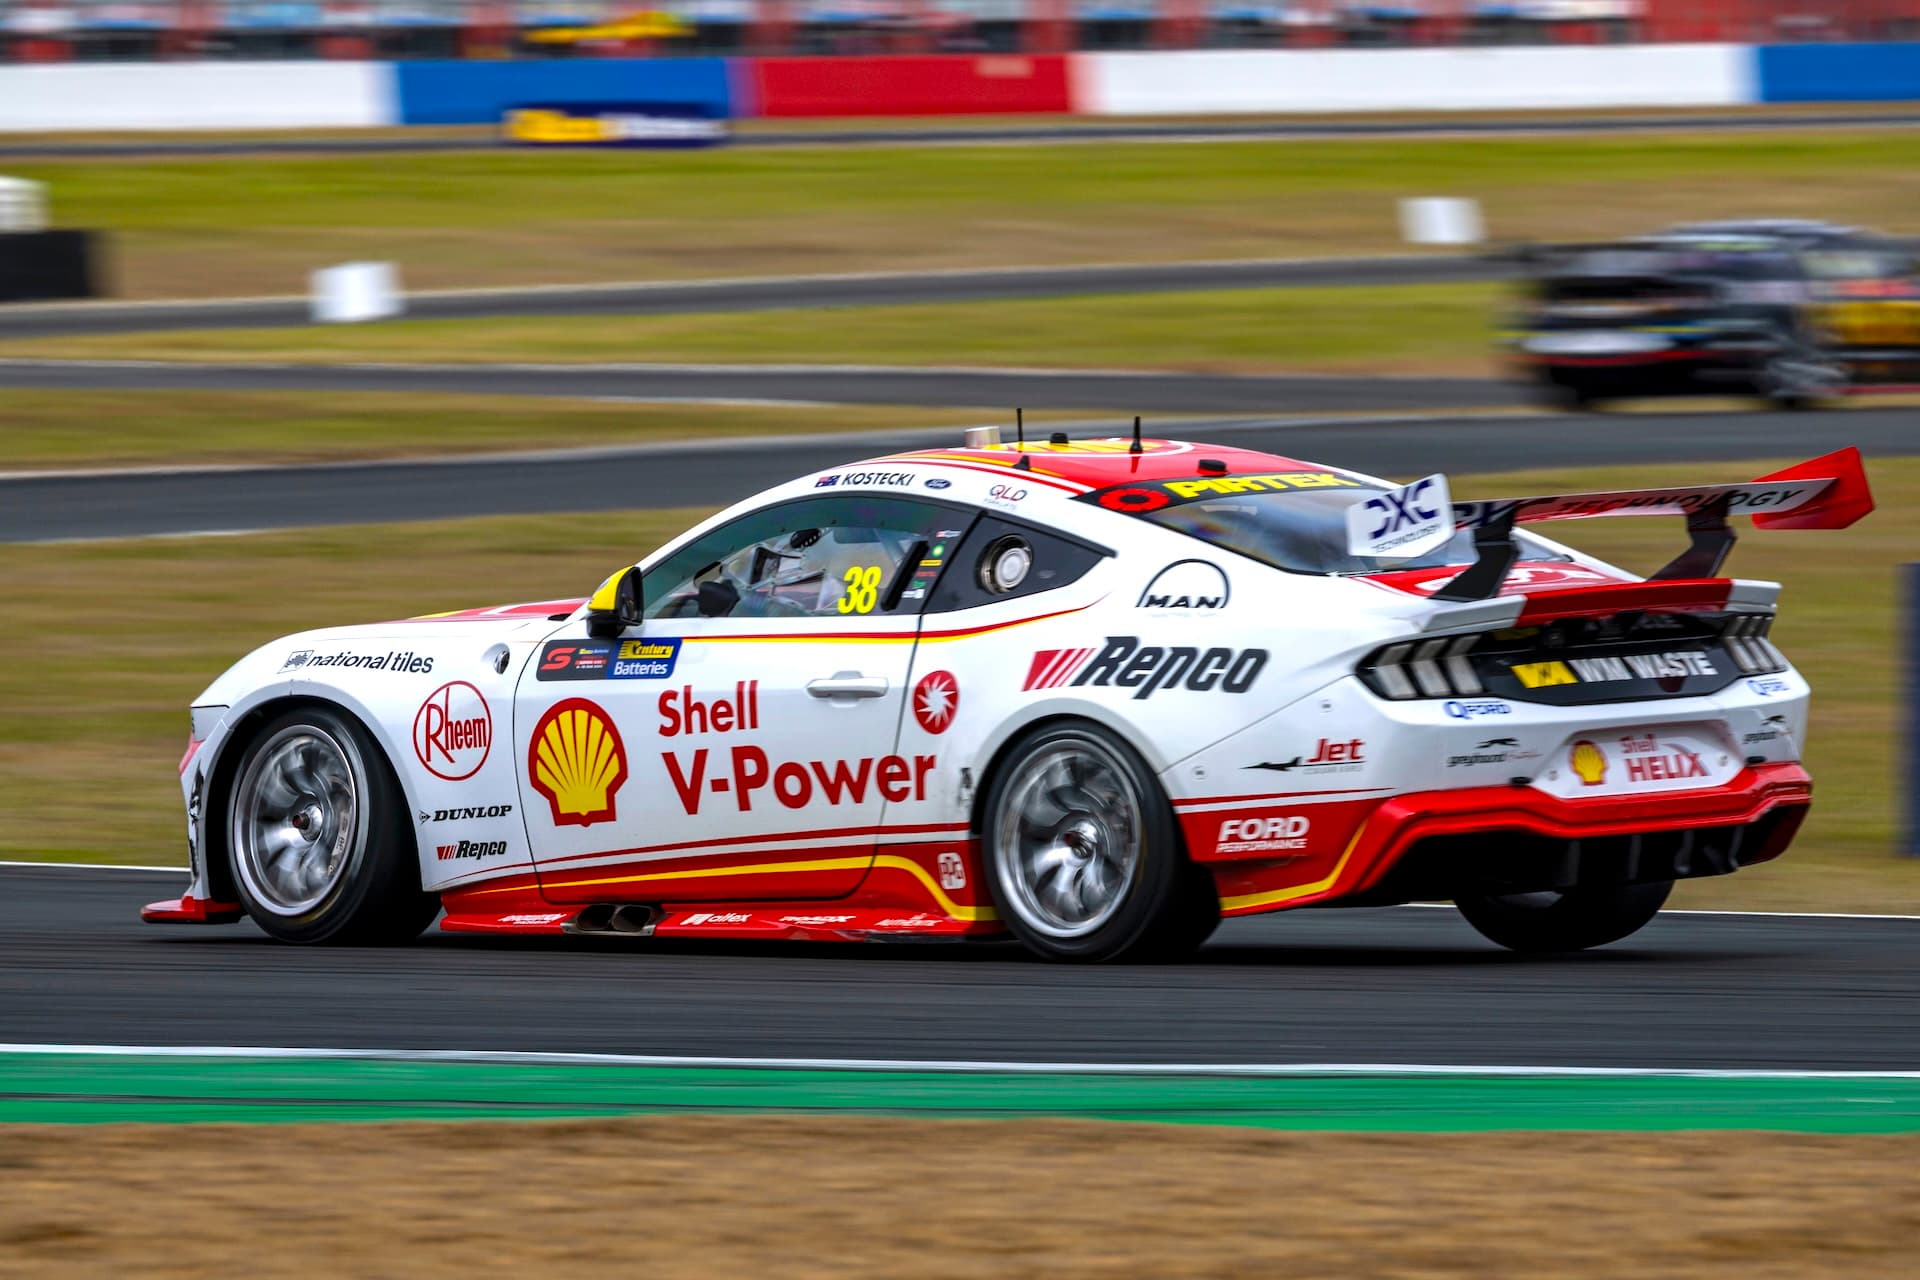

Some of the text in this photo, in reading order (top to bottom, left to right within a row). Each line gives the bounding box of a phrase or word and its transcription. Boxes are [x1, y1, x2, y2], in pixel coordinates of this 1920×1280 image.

[842, 472, 915, 486] KOSTECKI
[1163, 473, 1360, 498] PIRTEK
[990, 484, 1028, 501] QLD
[837, 566, 882, 614] 38
[1143, 594, 1223, 608] MAN
[630, 640, 674, 656] Century
[306, 651, 434, 673] national tiles
[613, 660, 669, 676] Batteries
[1070, 635, 1270, 700] Repco
[1567, 650, 1718, 682] WM WASTE
[658, 680, 759, 737] Shell
[425, 687, 487, 763] Rheem
[1306, 738, 1366, 763] Jet
[1620, 733, 1657, 754] Shell
[1624, 752, 1711, 782] HELIX
[661, 745, 936, 815] V-Power
[432, 804, 512, 822] DUNLOP
[1217, 815, 1310, 842] FORD
[456, 839, 508, 861] Repco
[1215, 837, 1308, 853] PERFORMANCE
